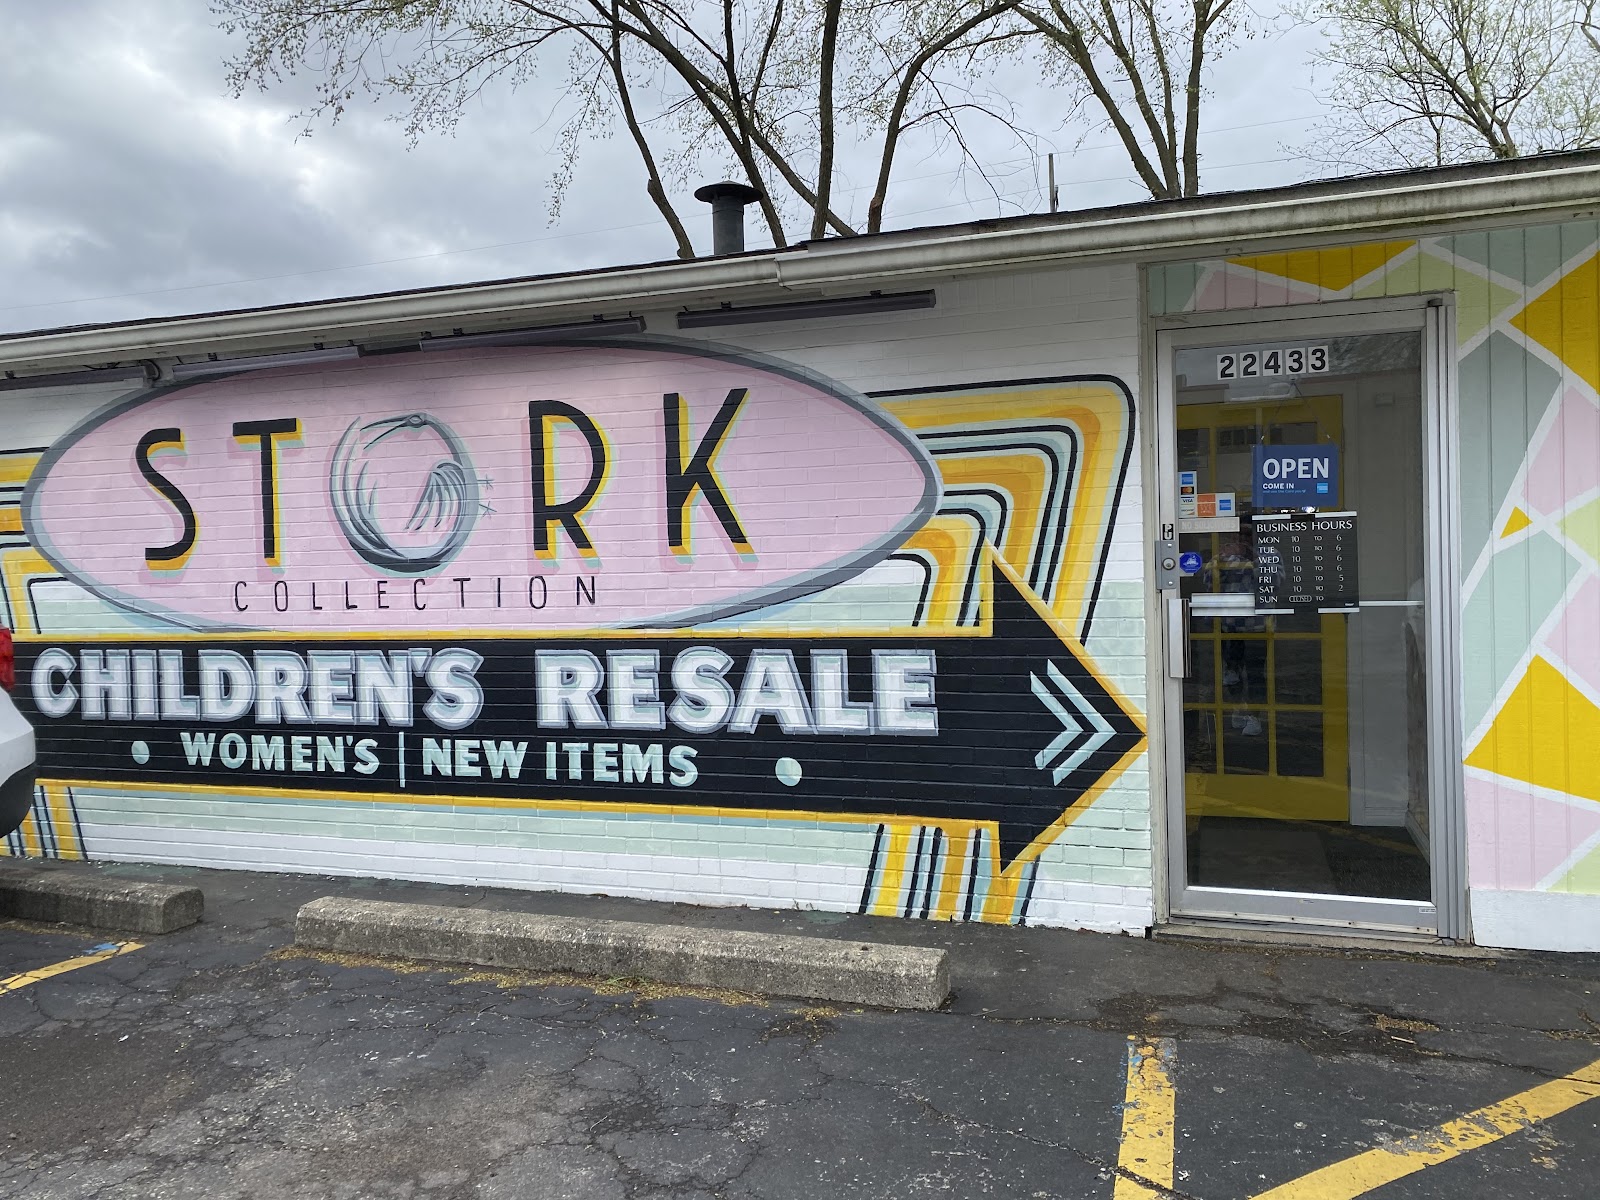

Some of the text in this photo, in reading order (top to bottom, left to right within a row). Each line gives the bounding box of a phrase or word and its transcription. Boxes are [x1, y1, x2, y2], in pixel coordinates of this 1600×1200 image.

[1220, 348, 1326, 379] 22433
[135, 388, 752, 573] STORK
[1262, 458, 1329, 480] OPEN
[1182, 521, 1192, 530] NO
[1256, 520, 1352, 532] BUSINESS HOURS
[234, 575, 596, 612] COLLECTION
[31, 646, 939, 736] CHILDREN'S RESALE
[180, 732, 698, 787] WOMEN'S NEW ITEMS
